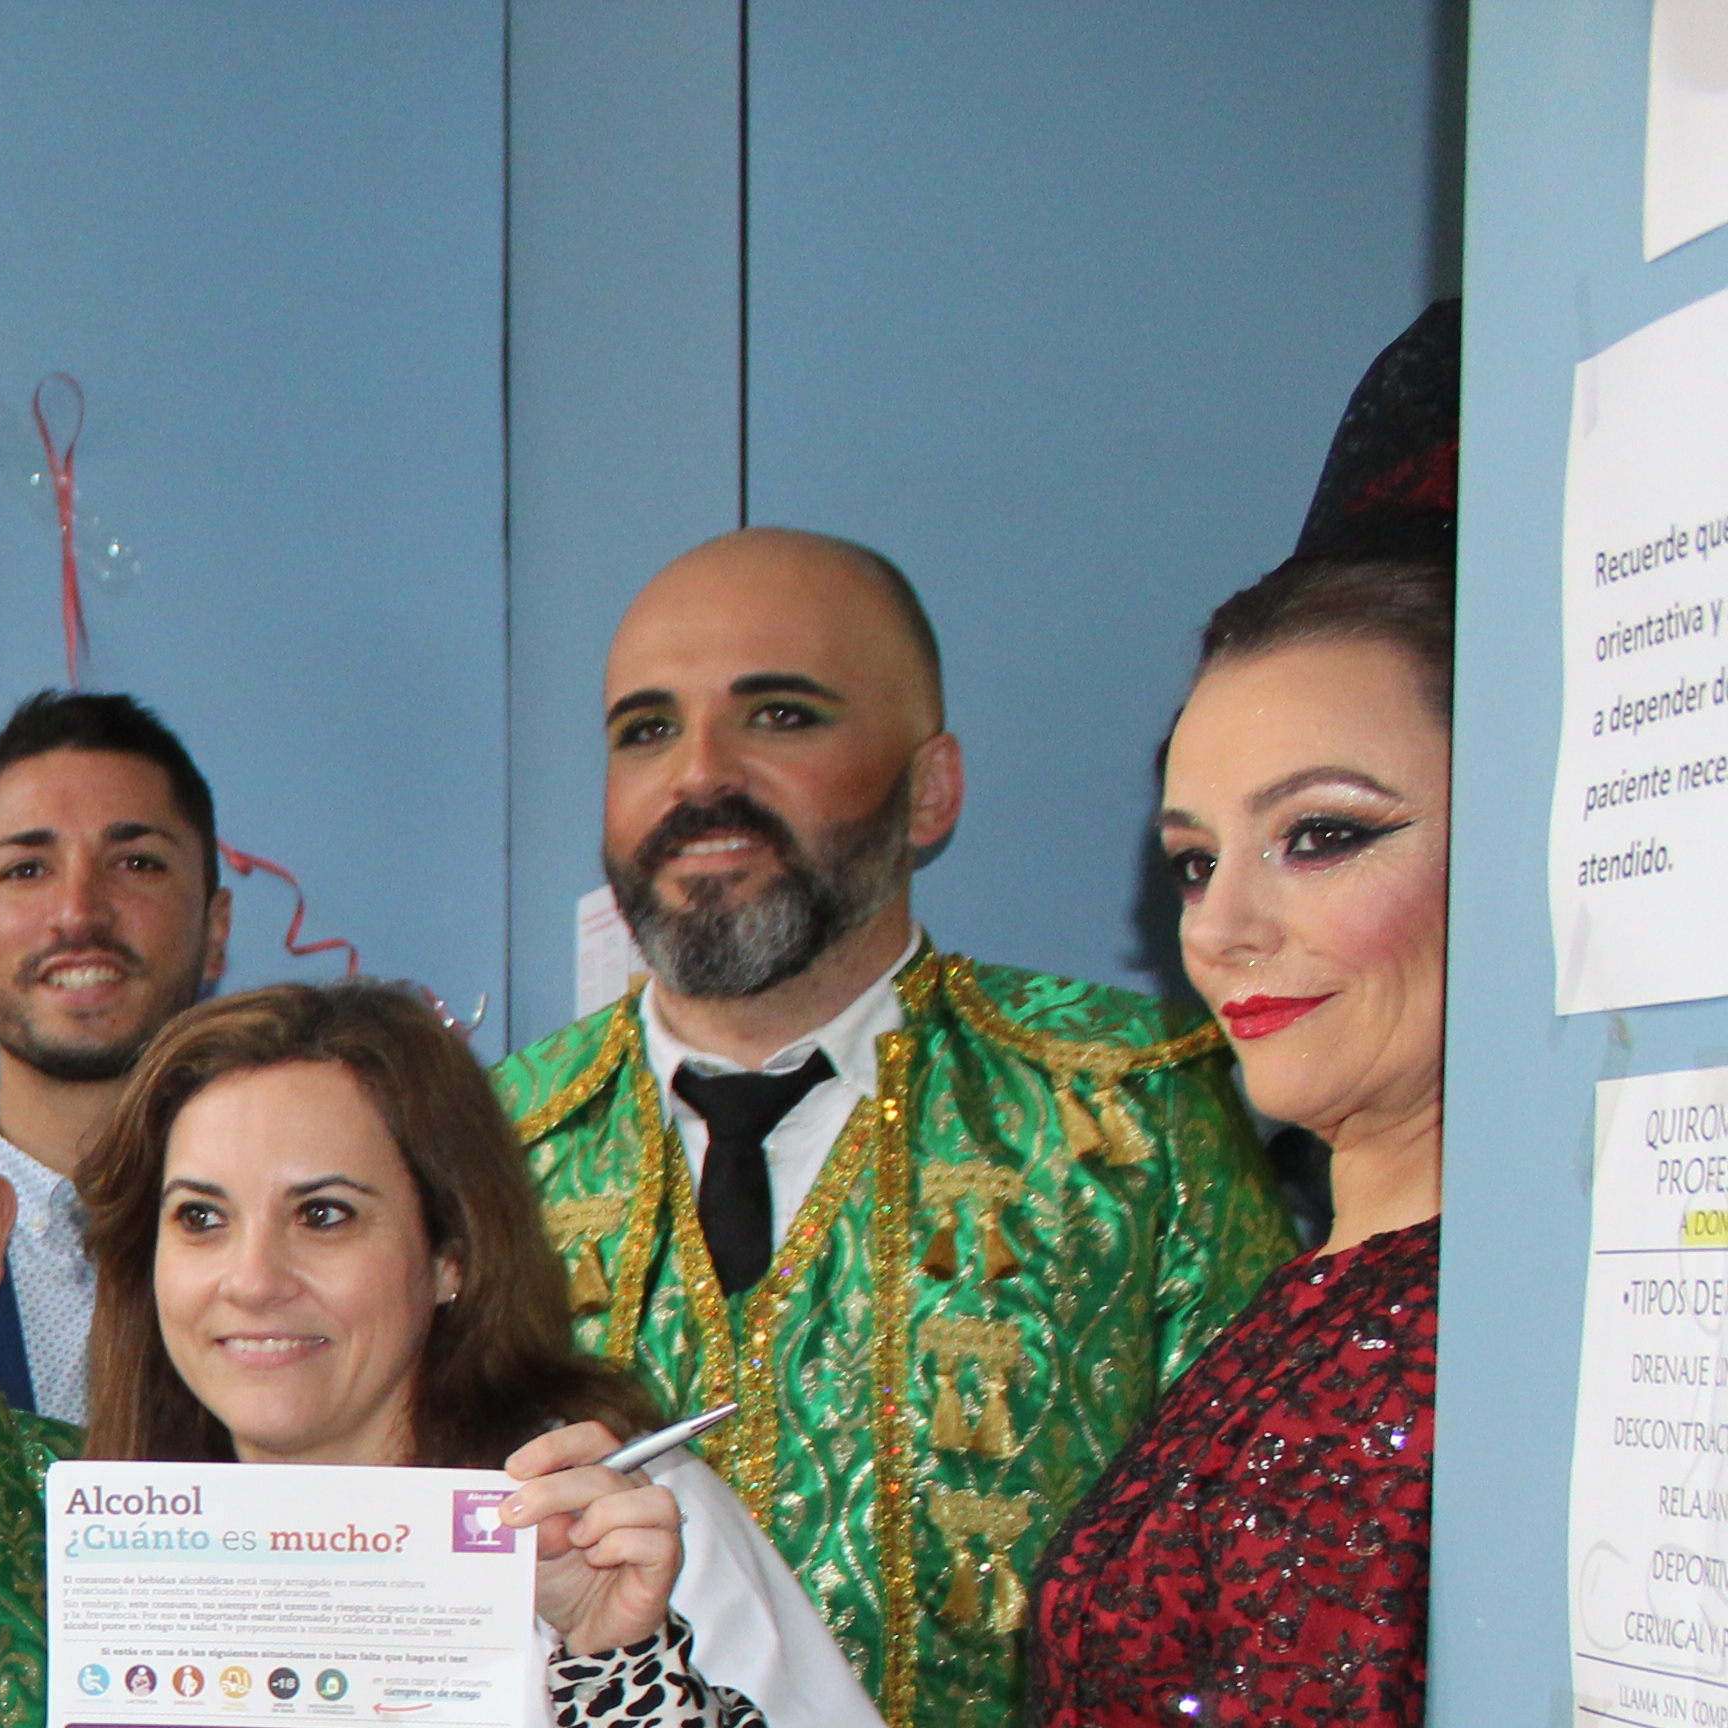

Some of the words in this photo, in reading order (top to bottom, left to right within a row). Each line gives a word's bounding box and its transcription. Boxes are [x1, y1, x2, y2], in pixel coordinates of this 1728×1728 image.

[1596, 524, 1689, 587] Recuerde
[1596, 602, 1704, 662] orientativa
[1711, 599, 1724, 636] y
[1592, 709, 1605, 736] a
[1610, 678, 1707, 736] depender
[1713, 667, 1728, 706] d
[1583, 766, 1671, 820] paciente
[1677, 754, 1728, 792] nece
[1578, 838, 1673, 887] atendido.
[1657, 1157, 1728, 1195] PROFE
[1632, 1354, 1710, 1386] DRENAJE
[65, 1486, 204, 1516] Alcohol
[64, 1523, 211, 1558] ¿Cuánto
[222, 1530, 257, 1551] es
[270, 1524, 411, 1553] mucho?
[1624, 1611, 1705, 1654] CERVICAL
[271, 1676, 297, 1690] -18
[1619, 1684, 1660, 1716] LLAMA
[1663, 1694, 1688, 1722] SIN
